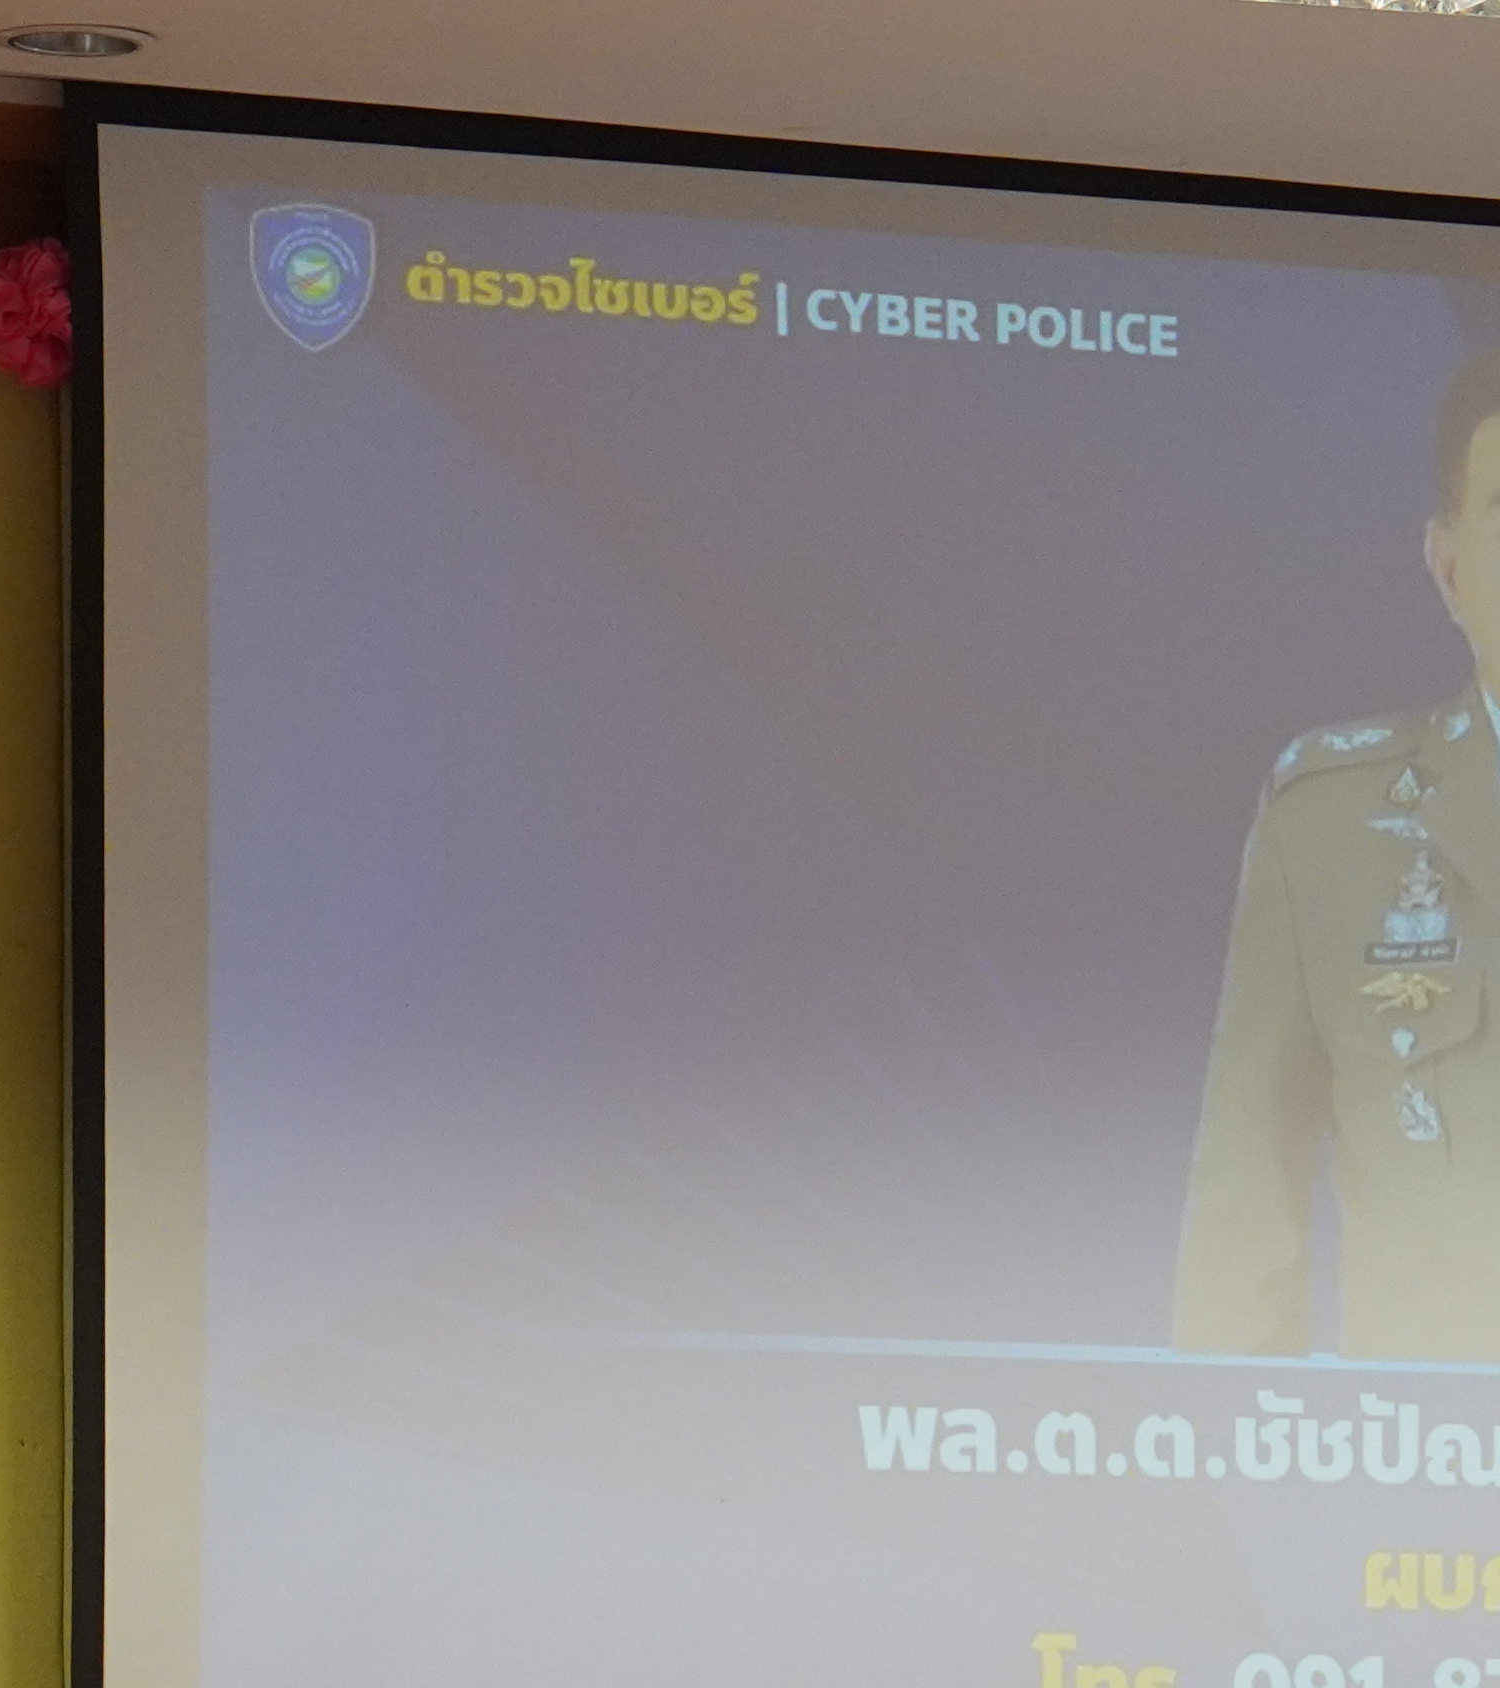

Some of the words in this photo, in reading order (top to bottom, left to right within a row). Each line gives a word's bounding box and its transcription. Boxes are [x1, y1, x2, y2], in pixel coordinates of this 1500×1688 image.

[405, 250, 760, 325] ตำรวจไซเบอร์
[806, 288, 980, 342] CYBER
[997, 303, 1178, 357] POLICE
